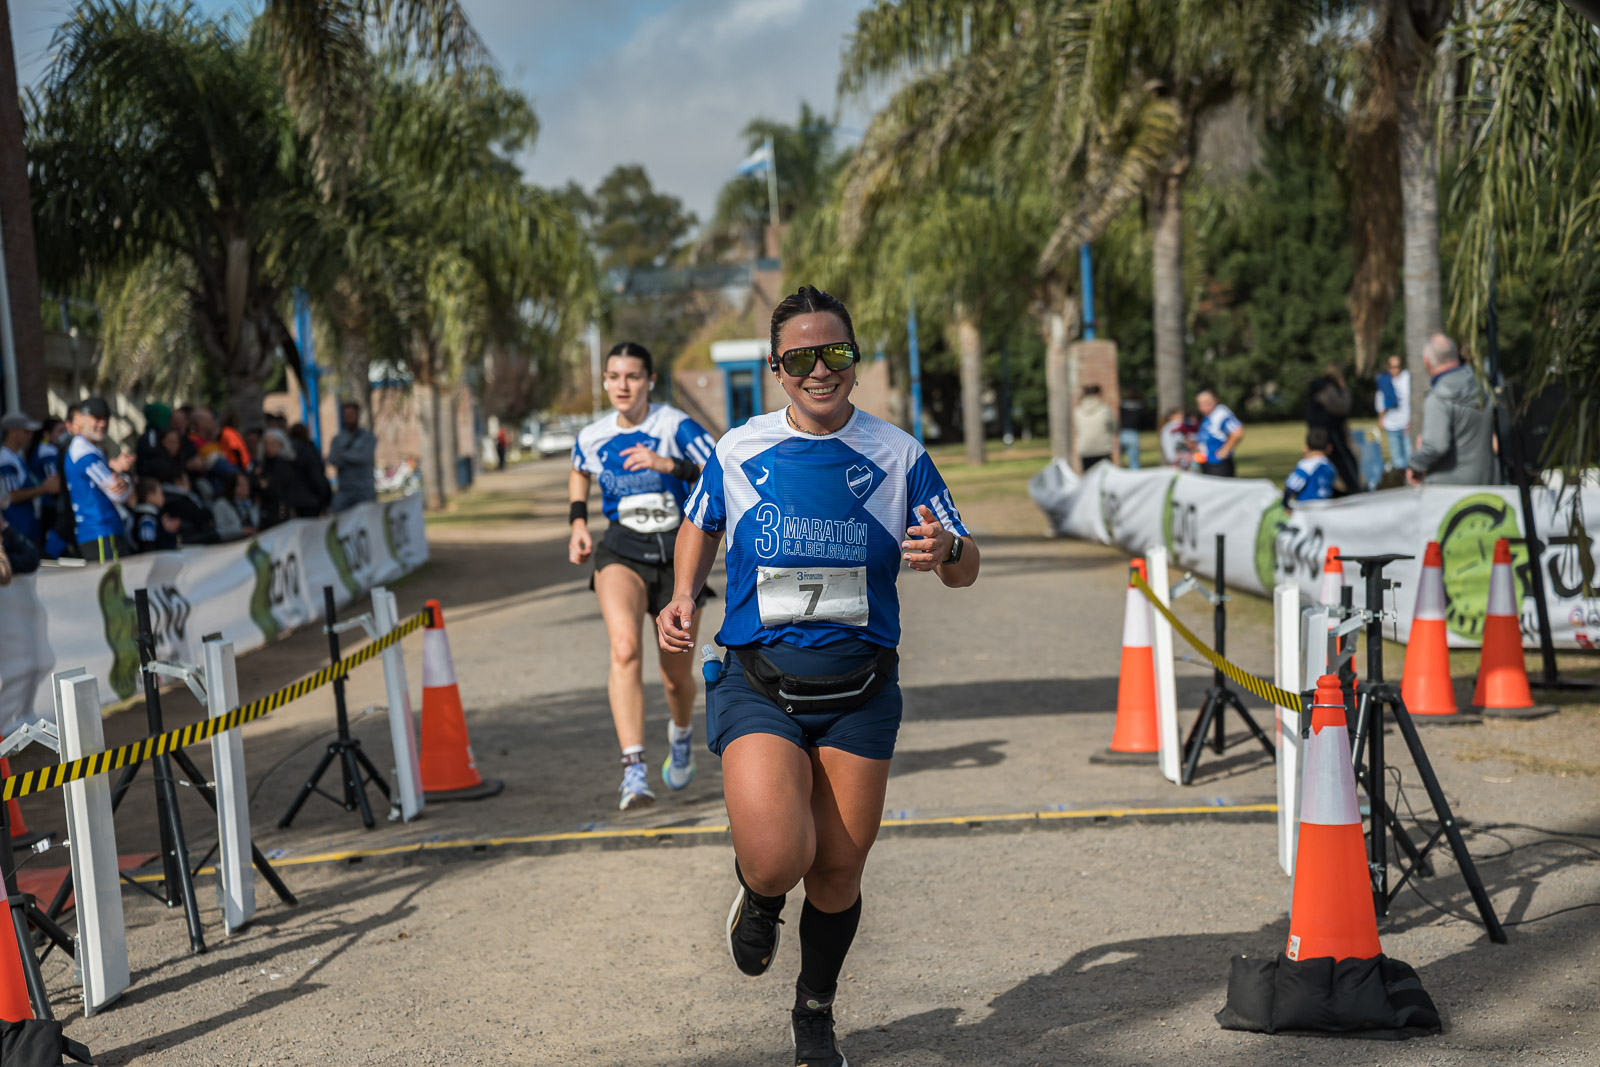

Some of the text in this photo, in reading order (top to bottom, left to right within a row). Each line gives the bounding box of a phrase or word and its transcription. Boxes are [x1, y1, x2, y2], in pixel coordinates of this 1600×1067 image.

[755, 502, 781, 559] 3
[783, 516, 868, 546] MARATÓN
[799, 584, 823, 615] 7
